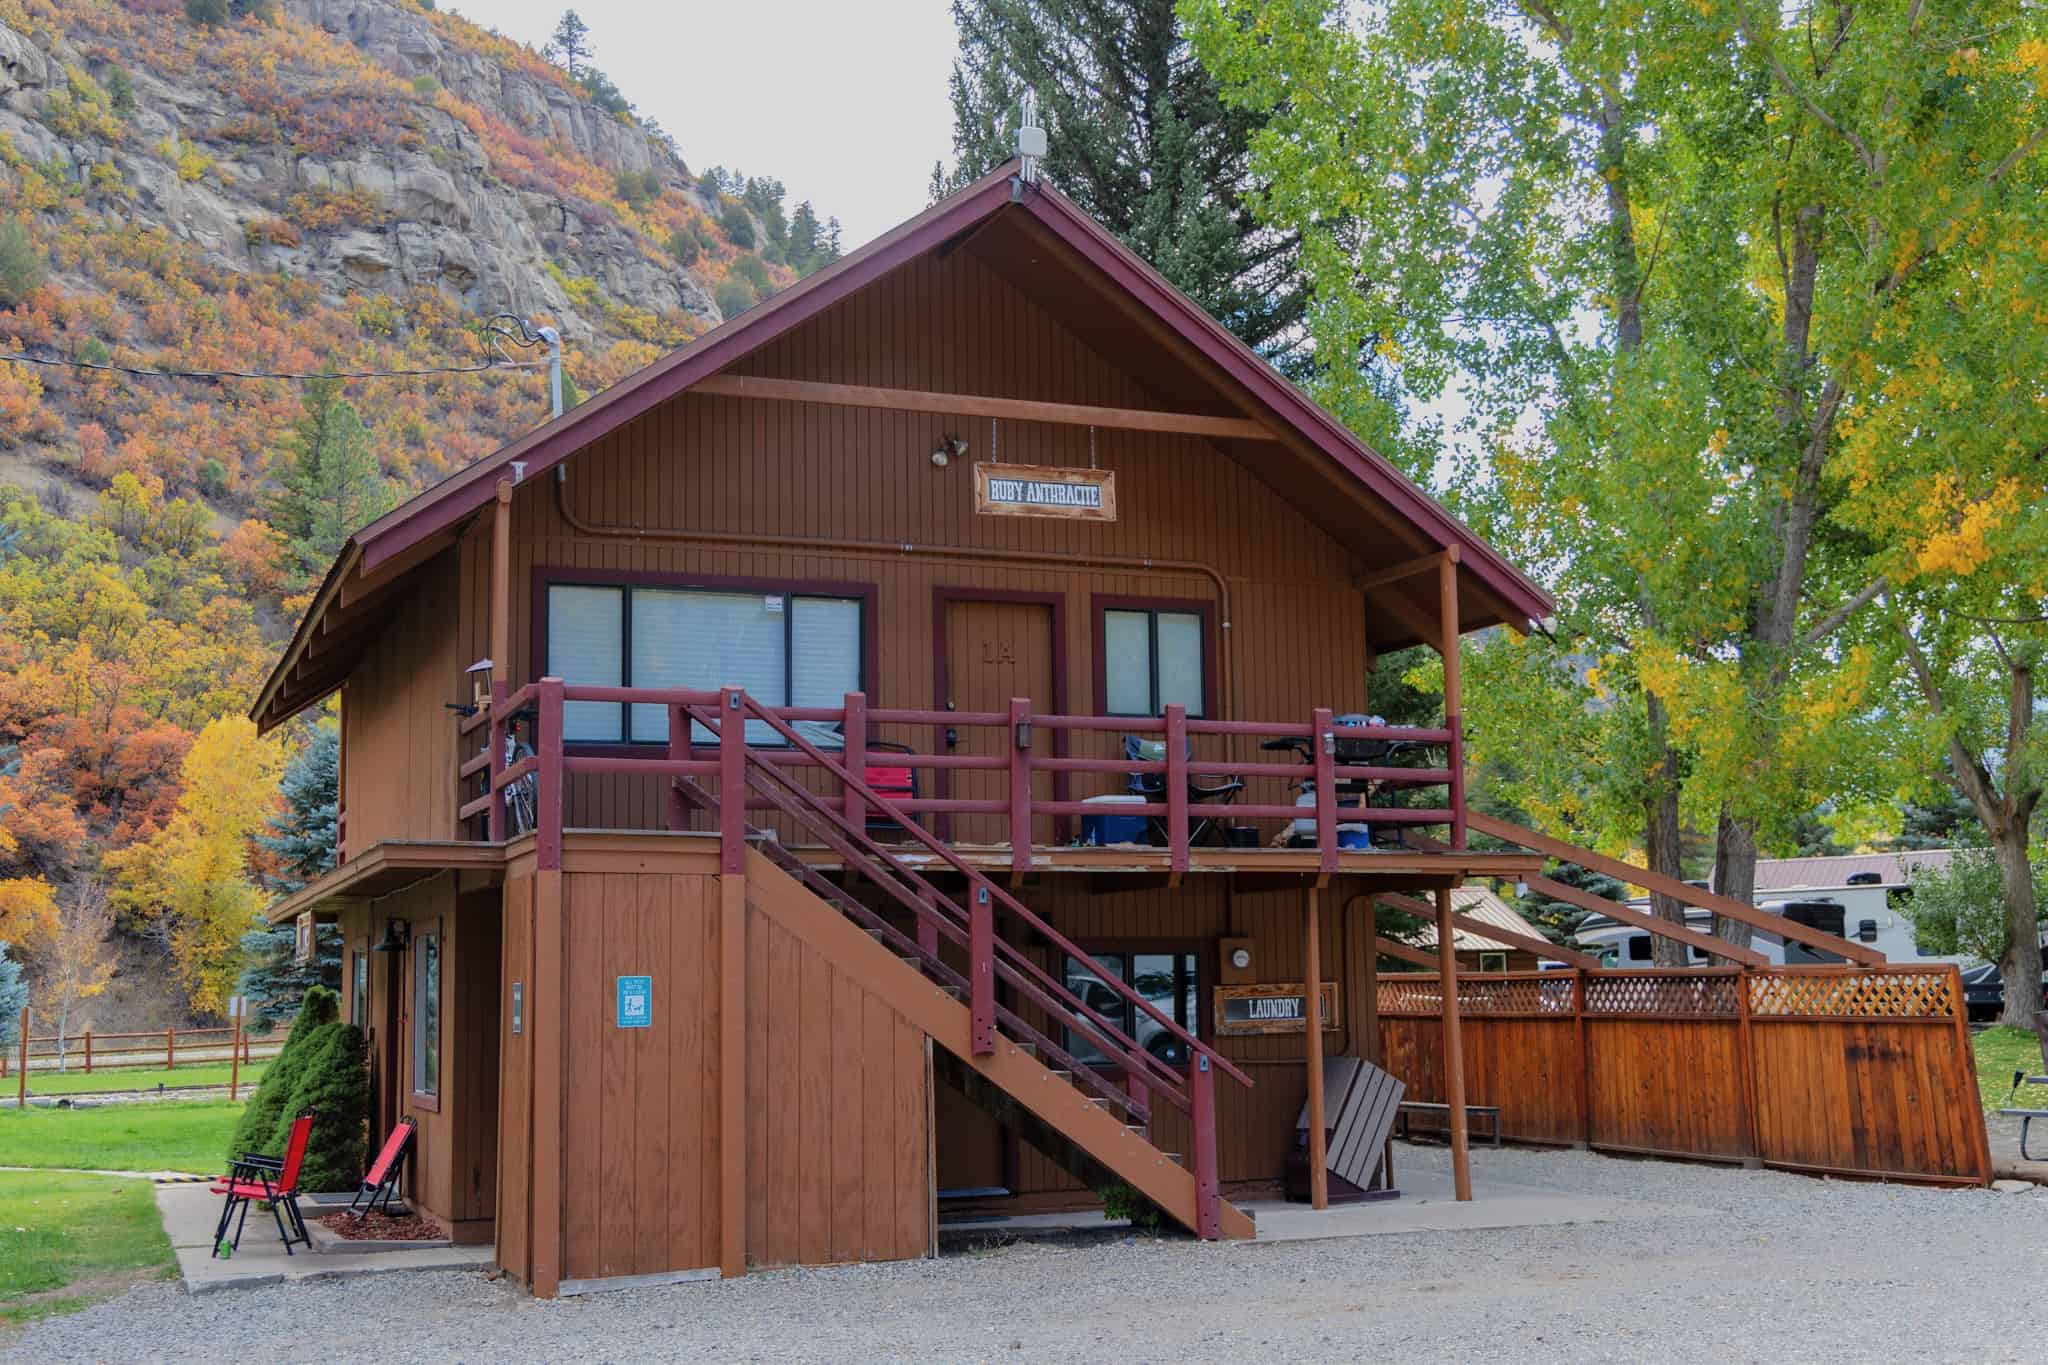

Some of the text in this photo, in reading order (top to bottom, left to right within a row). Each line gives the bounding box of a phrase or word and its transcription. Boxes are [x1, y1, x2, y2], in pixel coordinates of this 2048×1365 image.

[990, 480, 1100, 506] RUBY ANTHRACITE
[1248, 999, 1300, 1019] LAUNDRY
